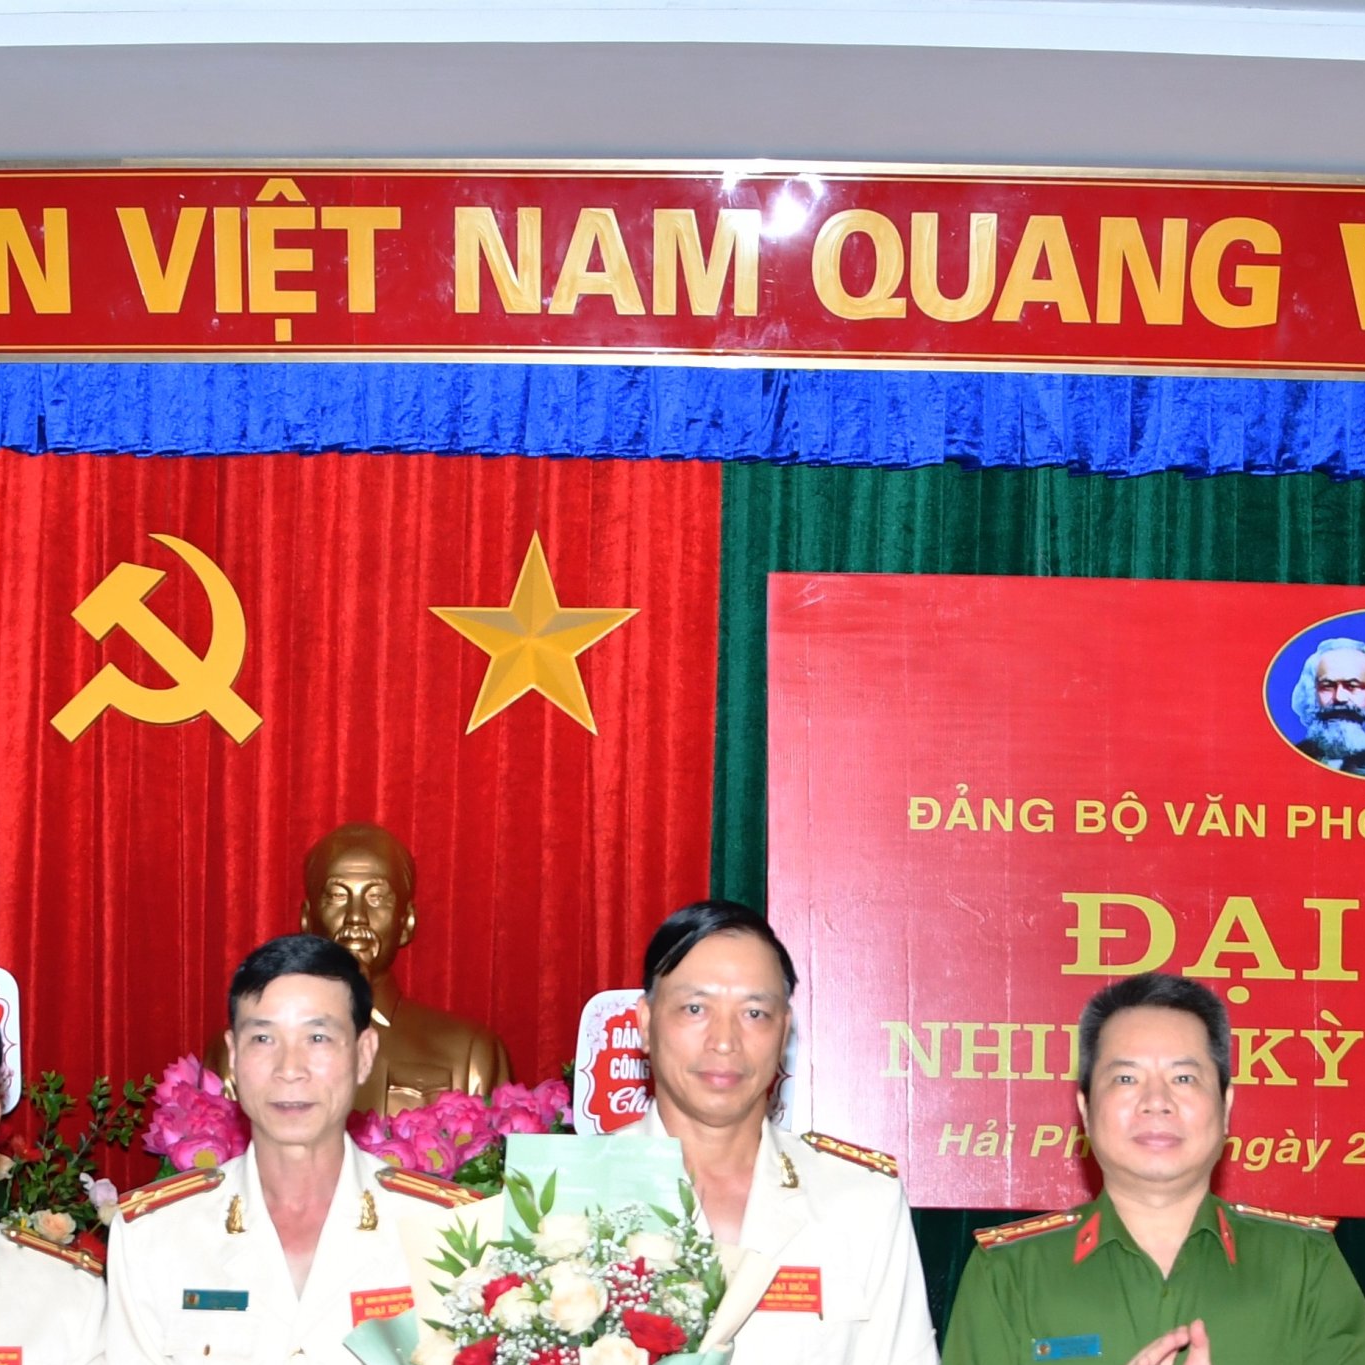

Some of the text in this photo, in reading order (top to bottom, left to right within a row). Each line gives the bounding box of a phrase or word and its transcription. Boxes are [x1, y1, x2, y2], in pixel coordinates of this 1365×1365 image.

[115, 178, 402, 342] VIỆT
[454, 206, 759, 317] NAM
[812, 211, 1282, 328] QUANG
[908, 783, 1055, 834] ĐẢNG
[1075, 791, 1148, 842] BỘ
[1164, 793, 1267, 838] VĂN
[1060, 891, 1360, 1004] ĐẠI
[611, 1020, 643, 1049] ĐẢN
[1230, 1009, 1365, 1087] KỲ
[937, 1118, 1017, 1158] Hải
[1222, 1128, 1332, 1173] ngày
